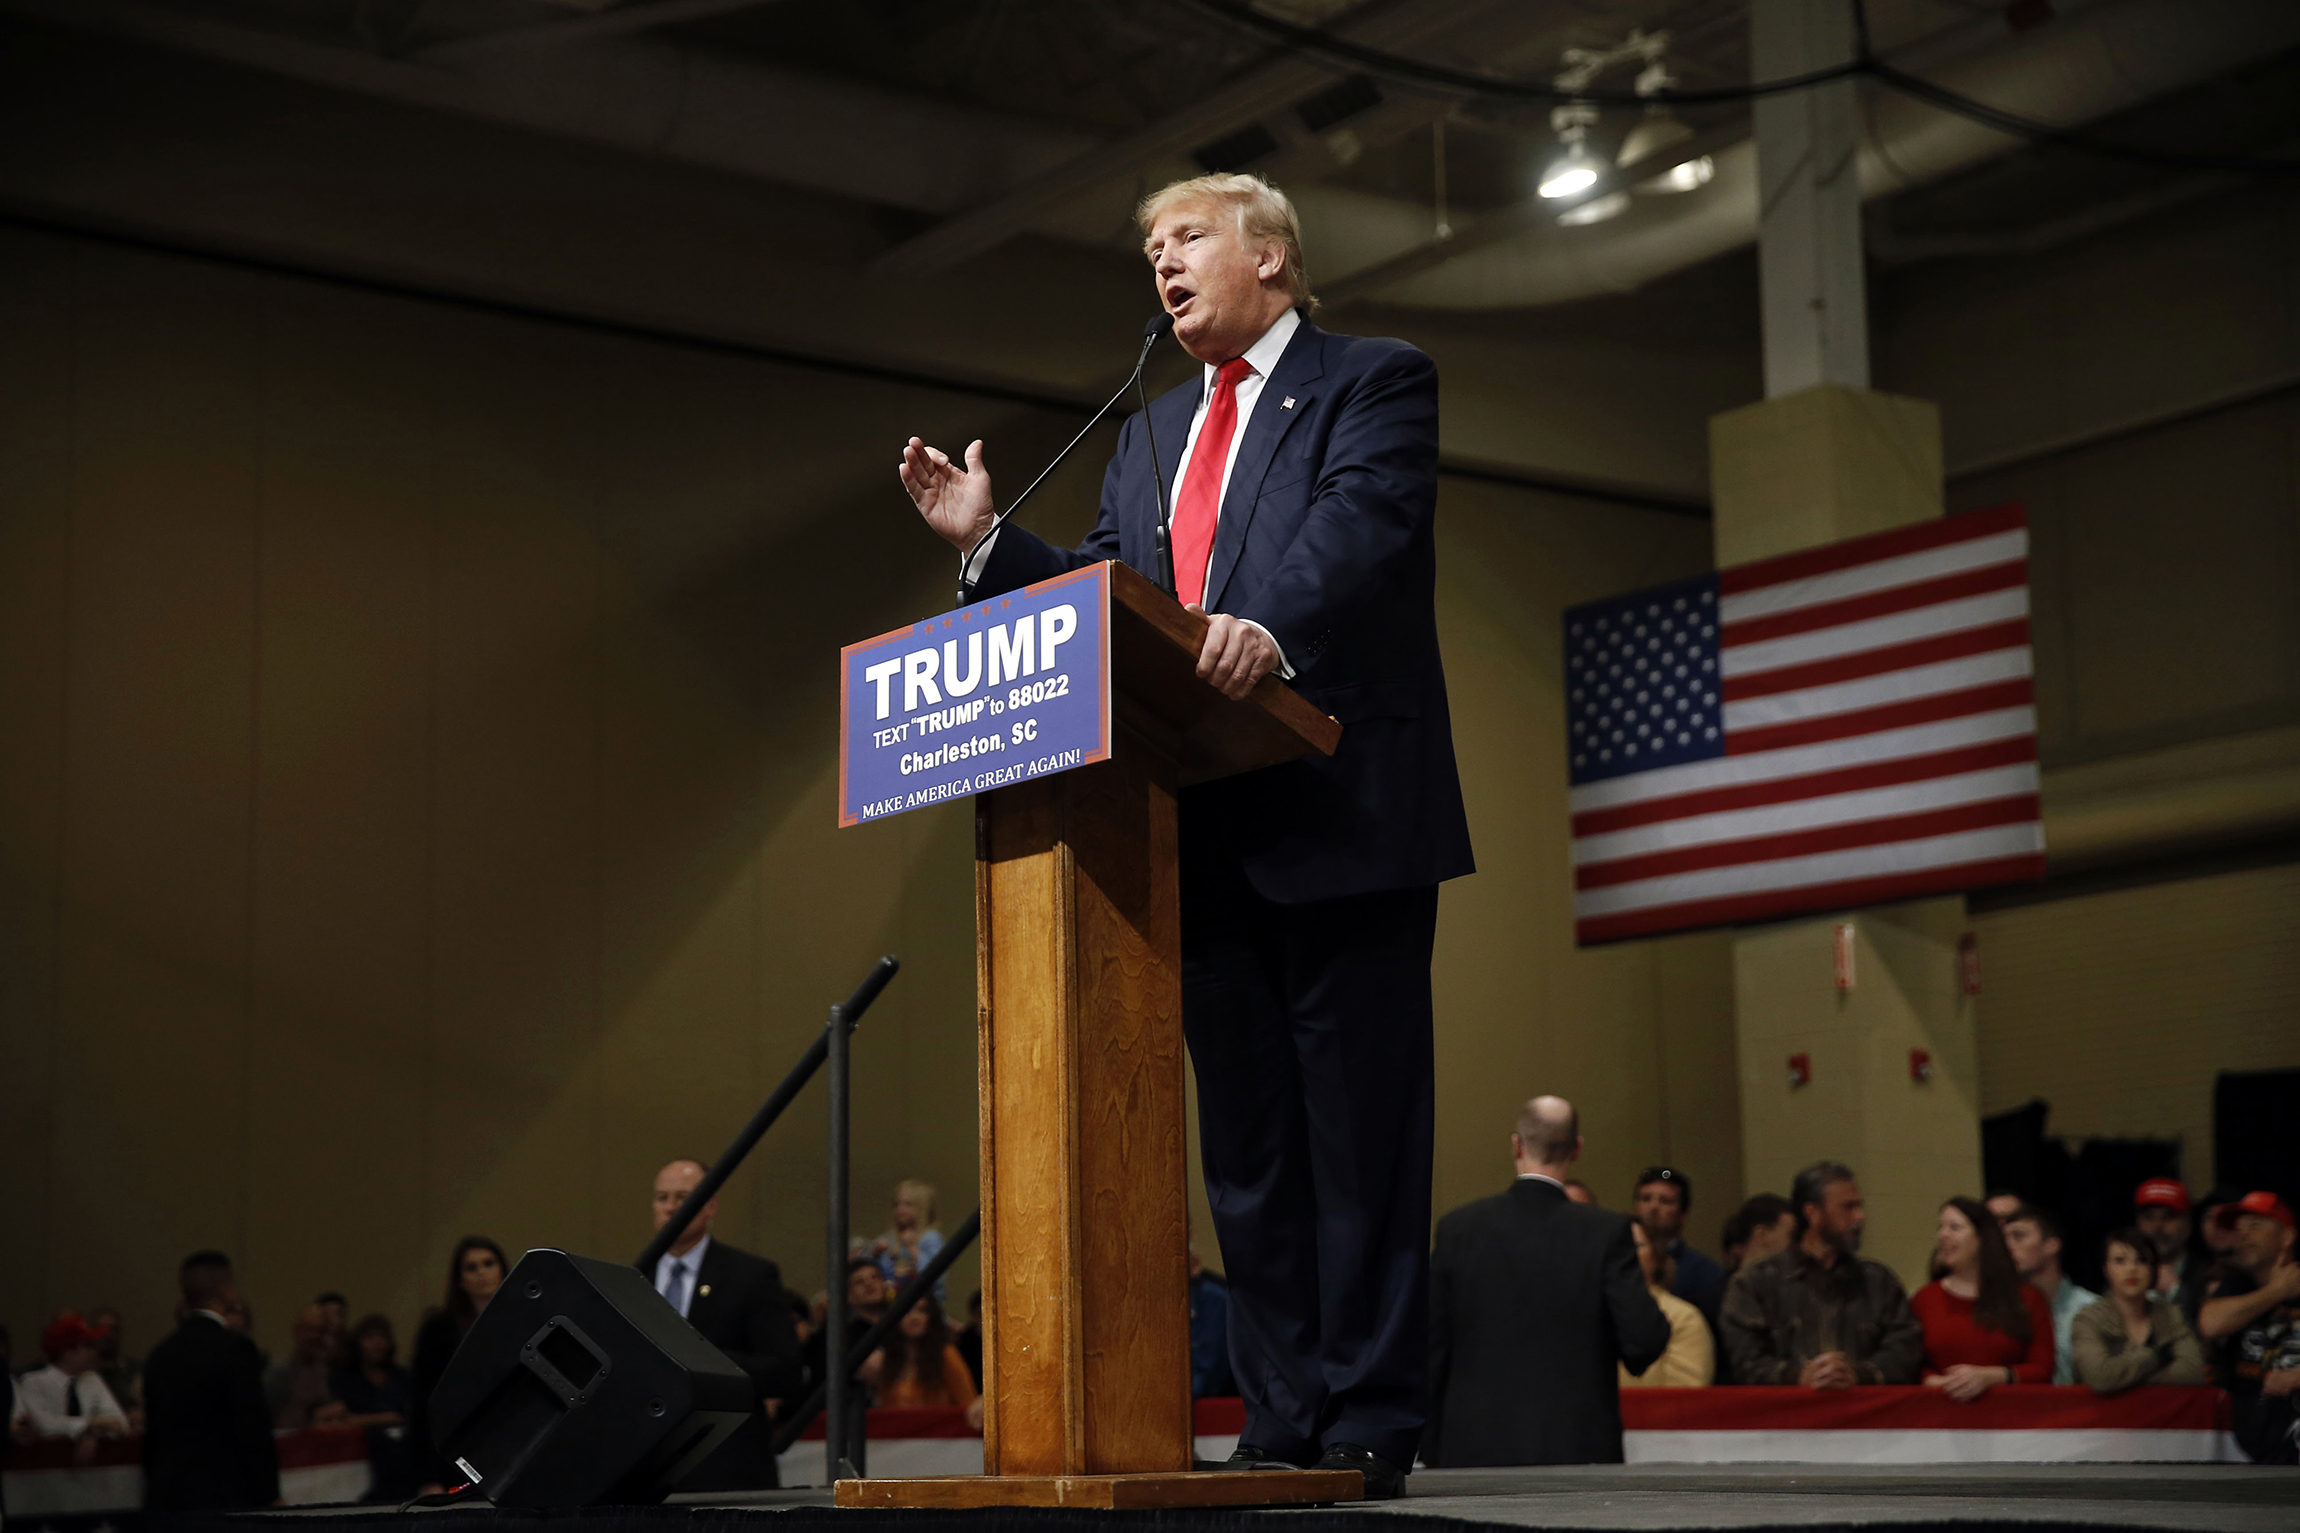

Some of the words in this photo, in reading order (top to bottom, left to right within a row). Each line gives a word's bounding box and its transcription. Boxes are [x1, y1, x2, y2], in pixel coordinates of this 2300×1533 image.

[865, 603, 1078, 721] TRUMP
[873, 723, 910, 749] TEXT
[989, 698, 1005, 716] to
[1008, 674, 1070, 711] 88022
[900, 732, 1006, 776] Charleston,
[1011, 718, 1039, 746] SC
[862, 795, 903, 820] MAKE
[905, 777, 972, 809] AMERICA
[974, 763, 1024, 790] GREAT
[1026, 748, 1082, 776] AGAIN!
